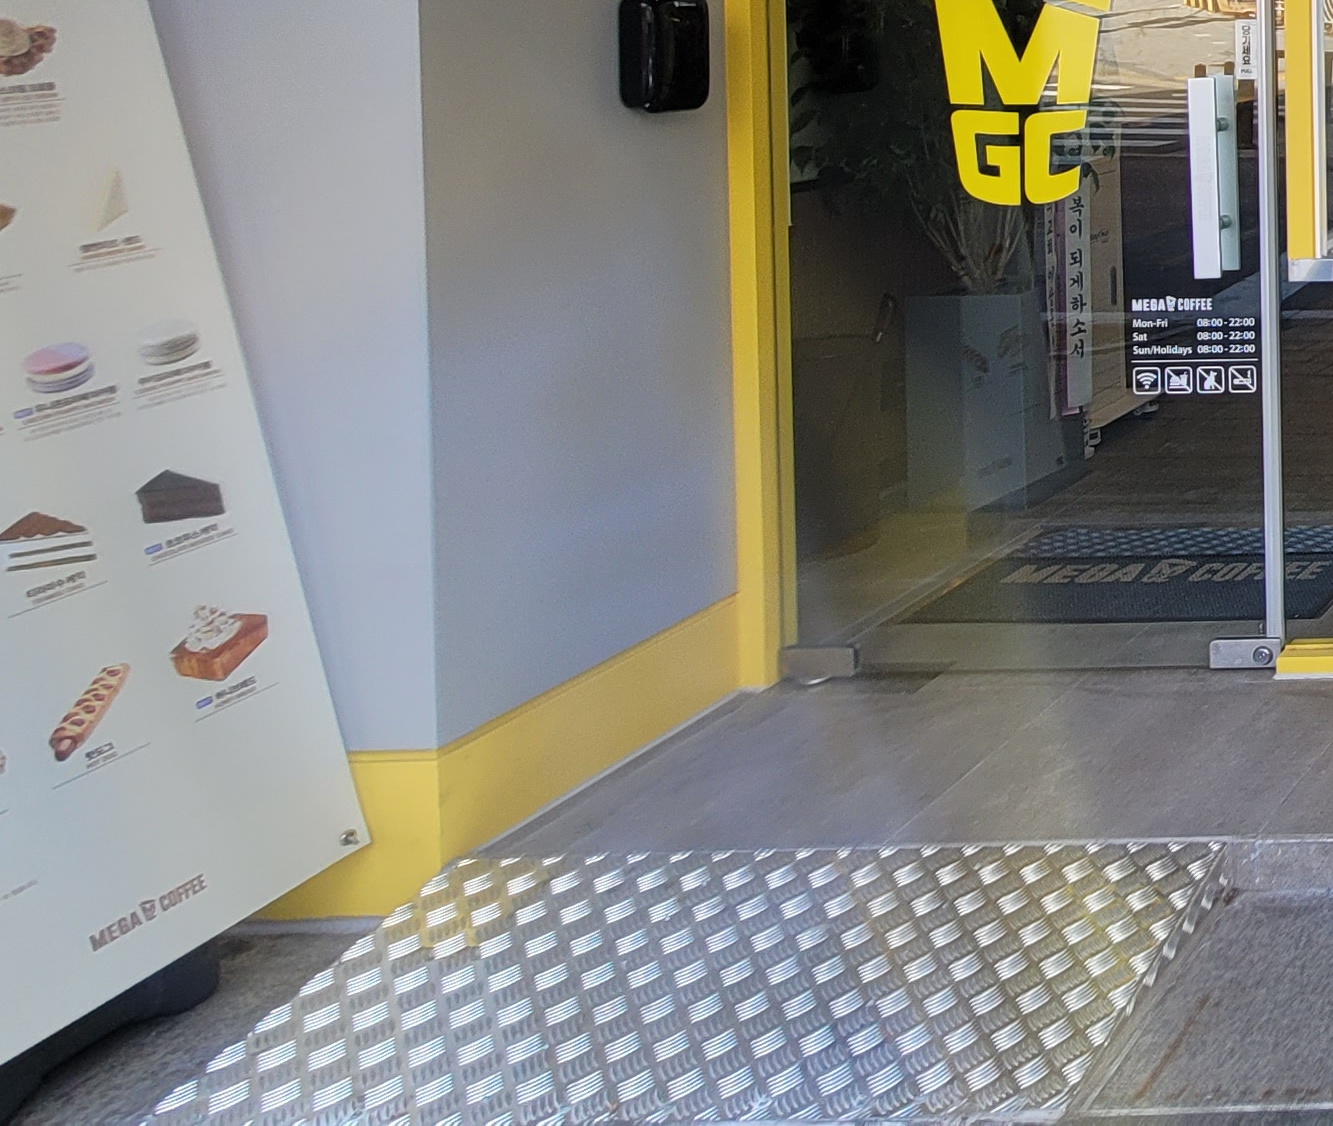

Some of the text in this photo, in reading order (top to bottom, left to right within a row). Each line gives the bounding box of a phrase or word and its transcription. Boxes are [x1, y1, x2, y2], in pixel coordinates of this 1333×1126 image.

[1241, 25, 1252, 65] 당기세요
[1131, 298, 1213, 312] MEGA COFFEE
[1132, 318, 1168, 328] Mon-Fri
[1132, 332, 1148, 342] Sat
[1132, 345, 1193, 356] Sun/Holidays
[1001, 561, 1331, 584] MEGA COFEE
[89, 873, 208, 952] MEGA COFFEE
